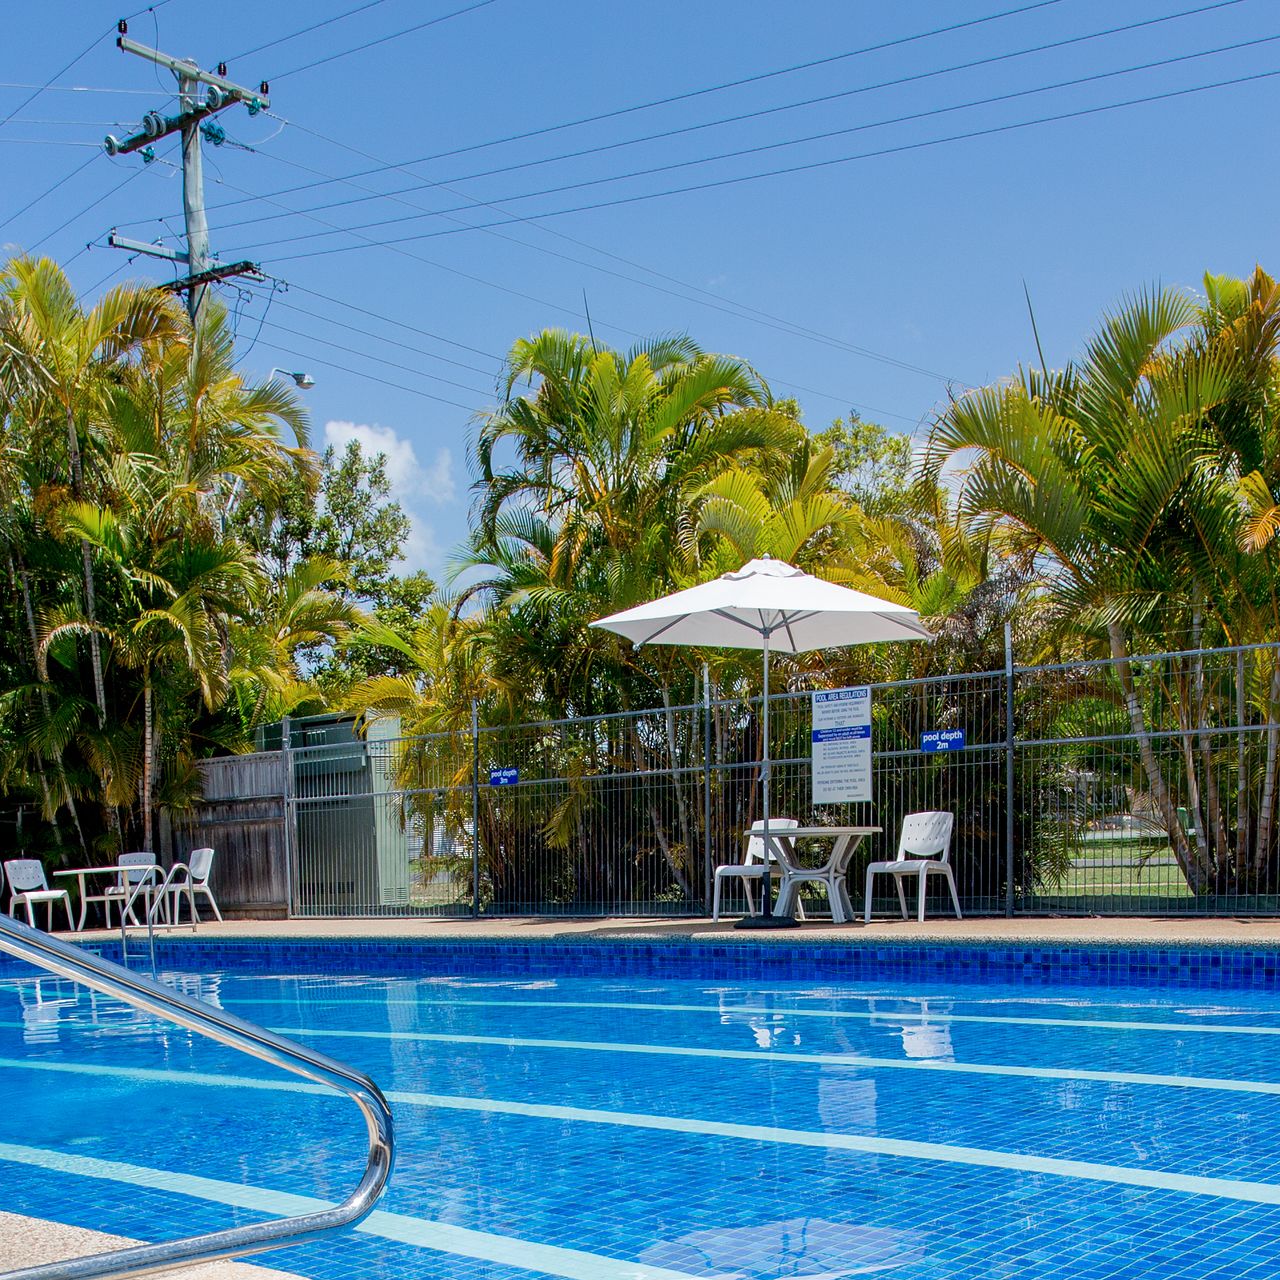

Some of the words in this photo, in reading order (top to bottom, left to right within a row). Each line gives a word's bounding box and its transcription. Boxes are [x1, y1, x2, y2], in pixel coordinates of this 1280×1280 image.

[816, 694, 827, 702] POOL
[828, 693, 838, 701] AREA
[839, 690, 866, 699] REGULATIONS
[923, 732, 939, 743] pool
[941, 730, 962, 741] depth
[936, 741, 948, 749] 2m
[491, 770, 502, 779] pool
[503, 769, 517, 777] depth
